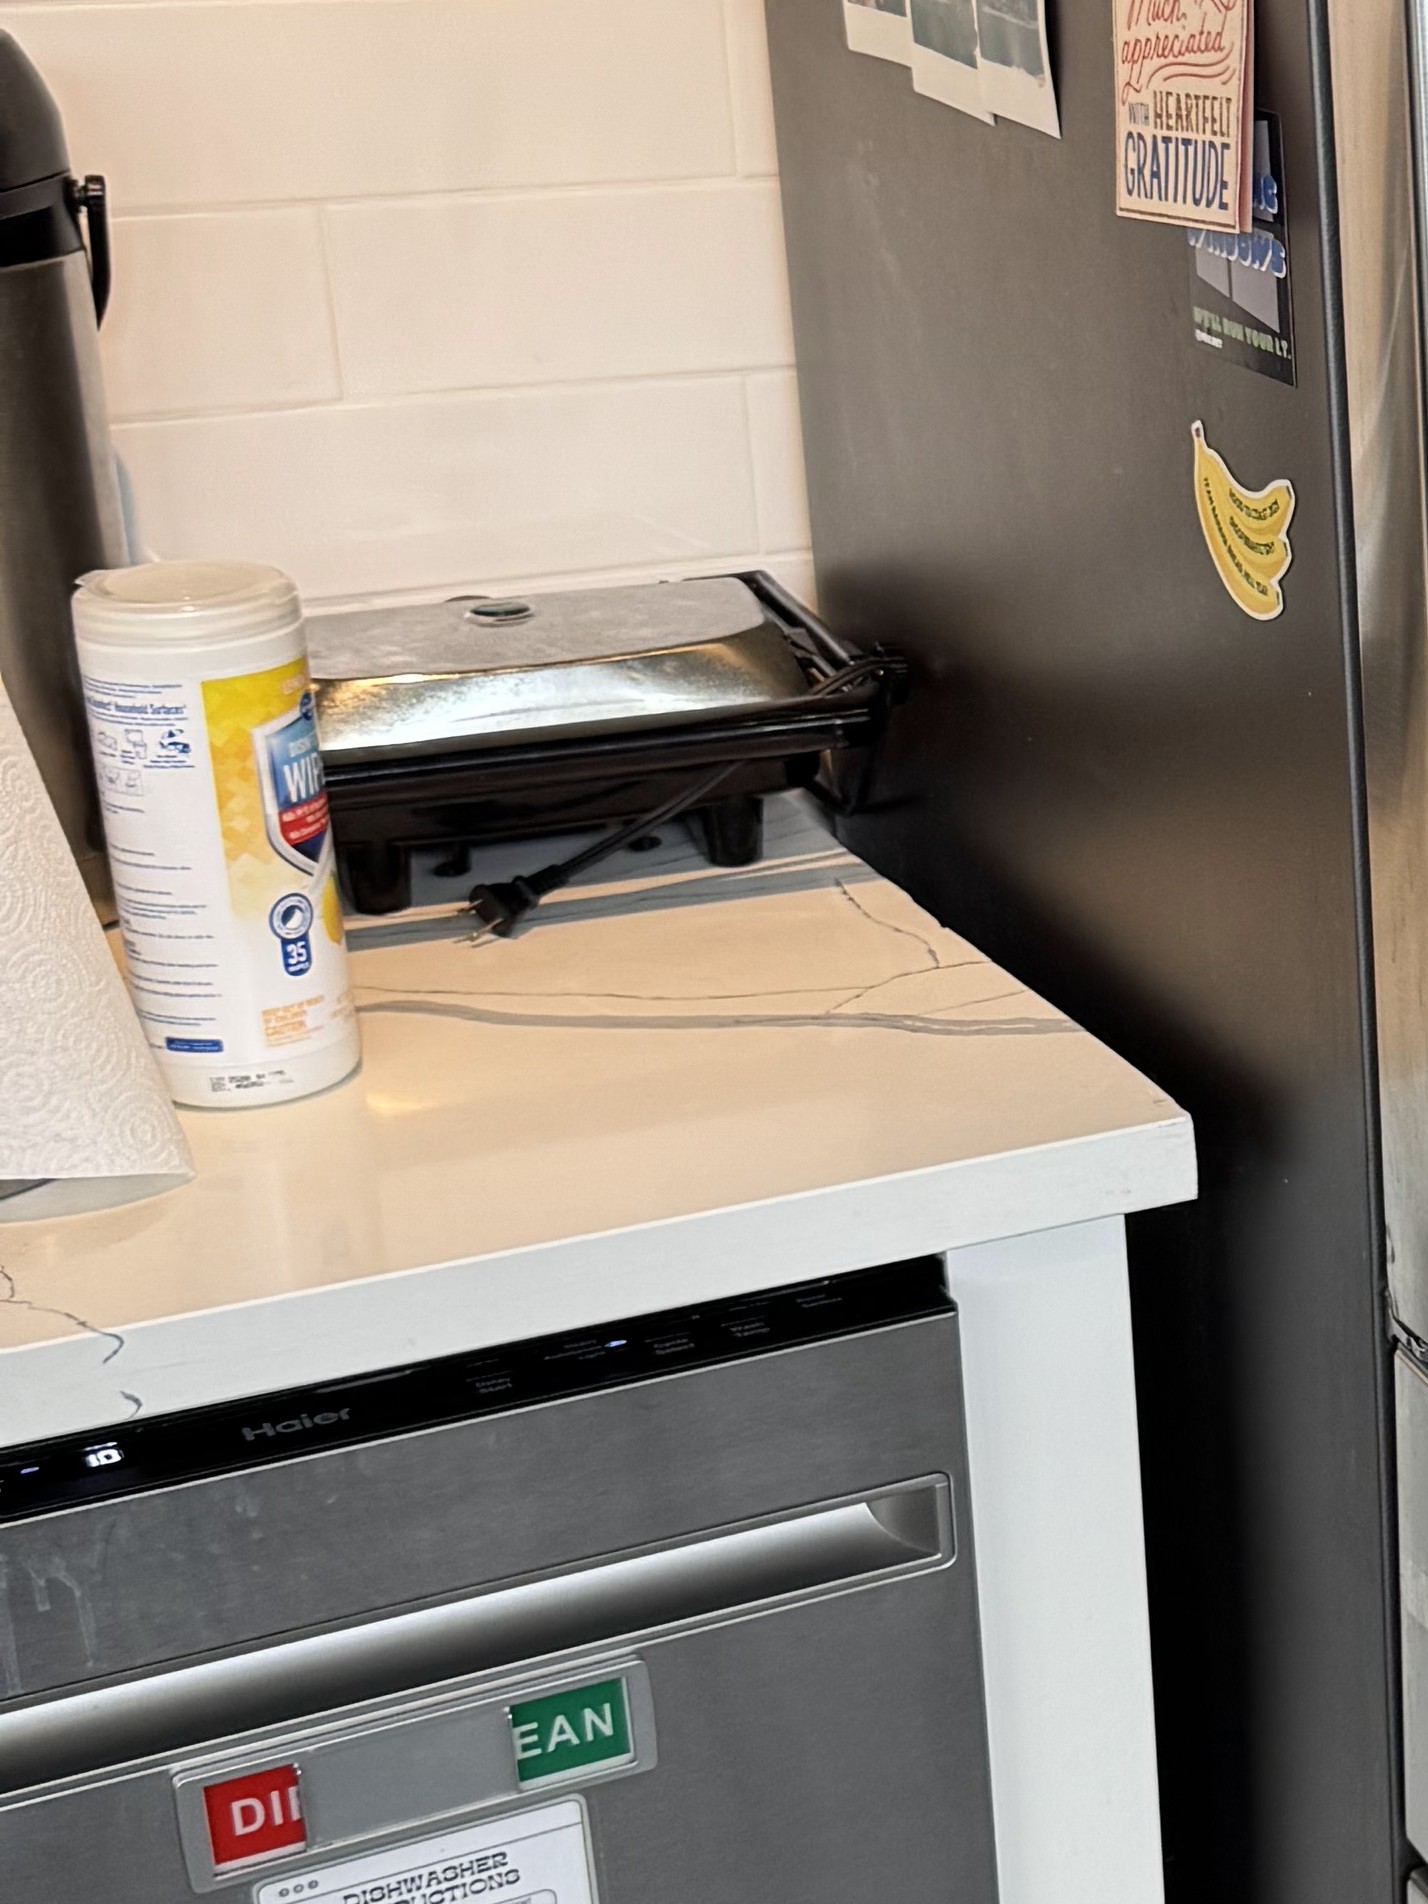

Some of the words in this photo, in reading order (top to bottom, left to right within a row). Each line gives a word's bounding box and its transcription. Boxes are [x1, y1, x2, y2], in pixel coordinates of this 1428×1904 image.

[1121, 1, 1232, 96] appreciated
[1152, 89, 1233, 139] HEARTFELT
[1123, 130, 1231, 212] GRATITUDE
[286, 940, 308, 965] 35
[241, 1408, 350, 1441] Haier
